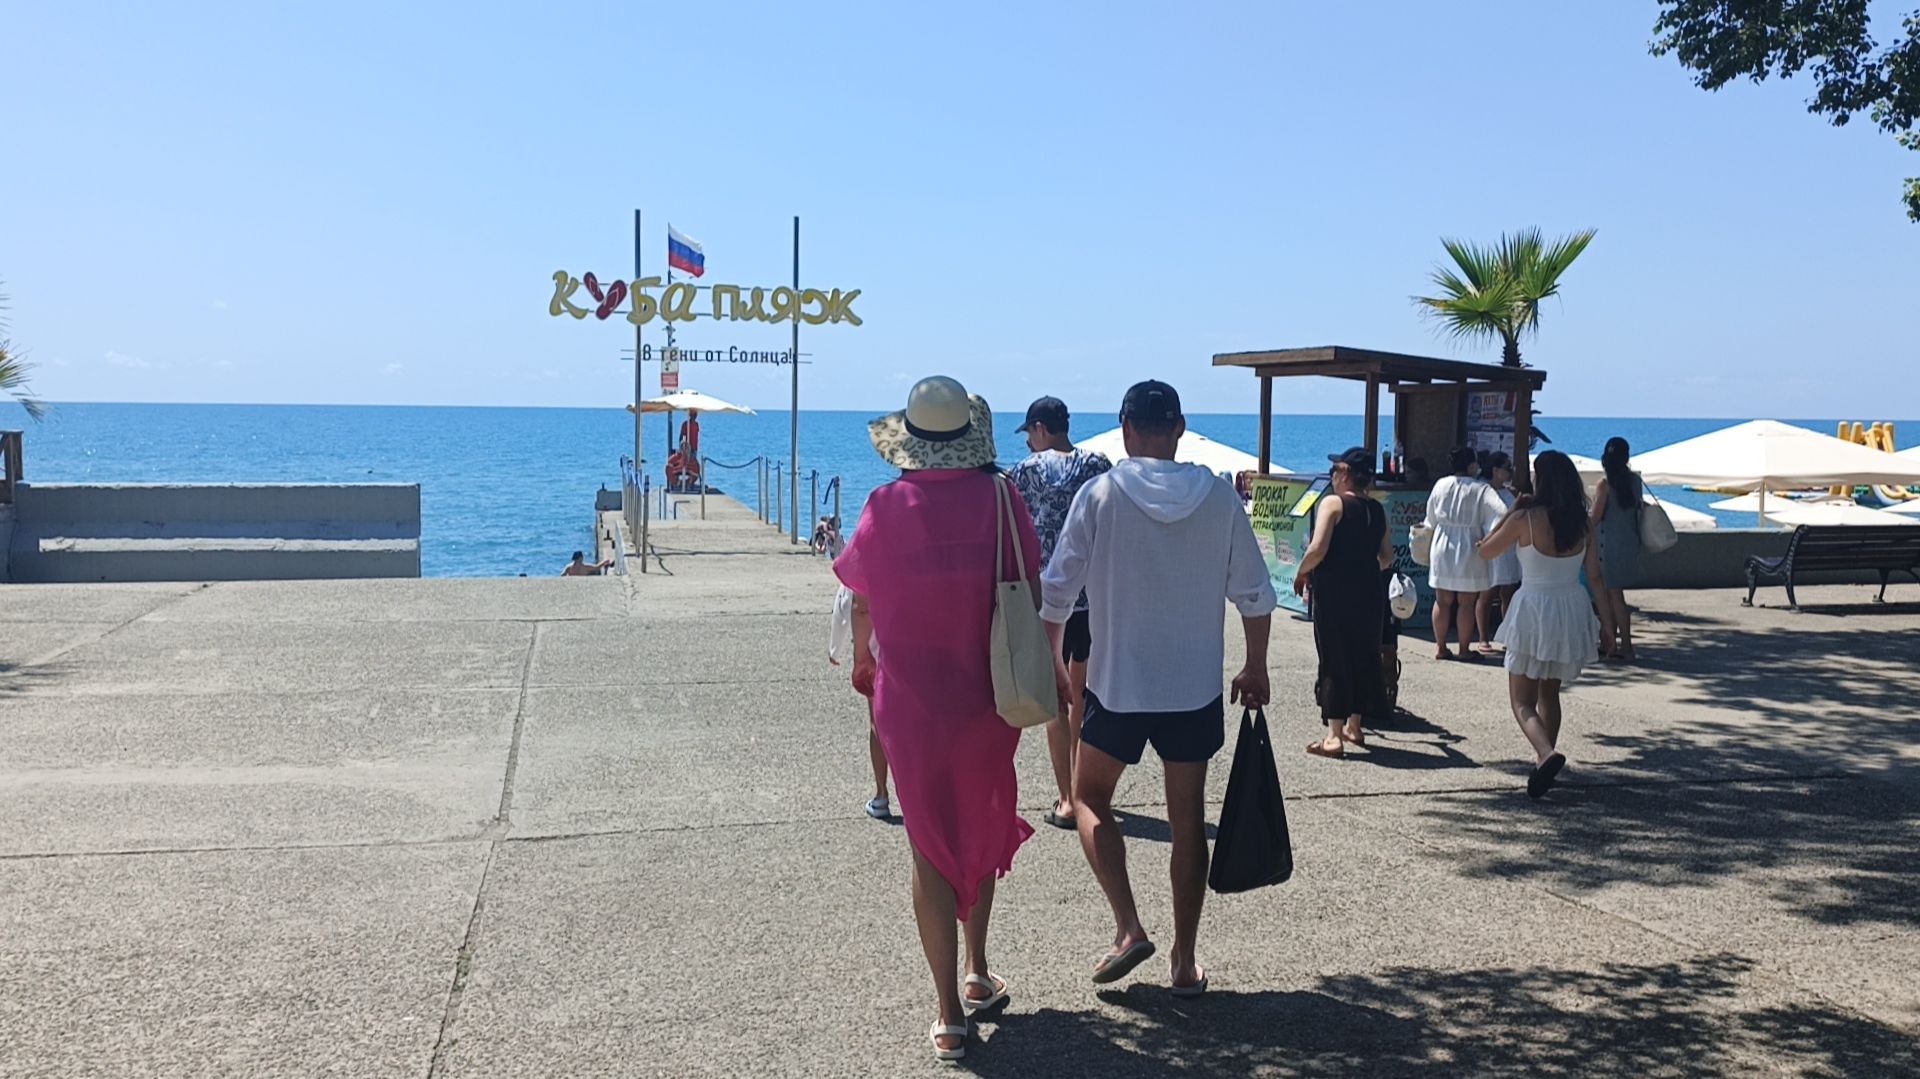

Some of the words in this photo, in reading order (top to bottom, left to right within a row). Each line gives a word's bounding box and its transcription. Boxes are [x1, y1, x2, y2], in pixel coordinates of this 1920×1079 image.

[642, 344, 652, 361] В
[660, 347, 698, 362] тени
[705, 349, 723, 362] от
[729, 345, 793, 366] Солнца!
[1255, 486, 1289, 502] ПРОКАТ
[1252, 503, 1290, 518] ВОДНЫХ
